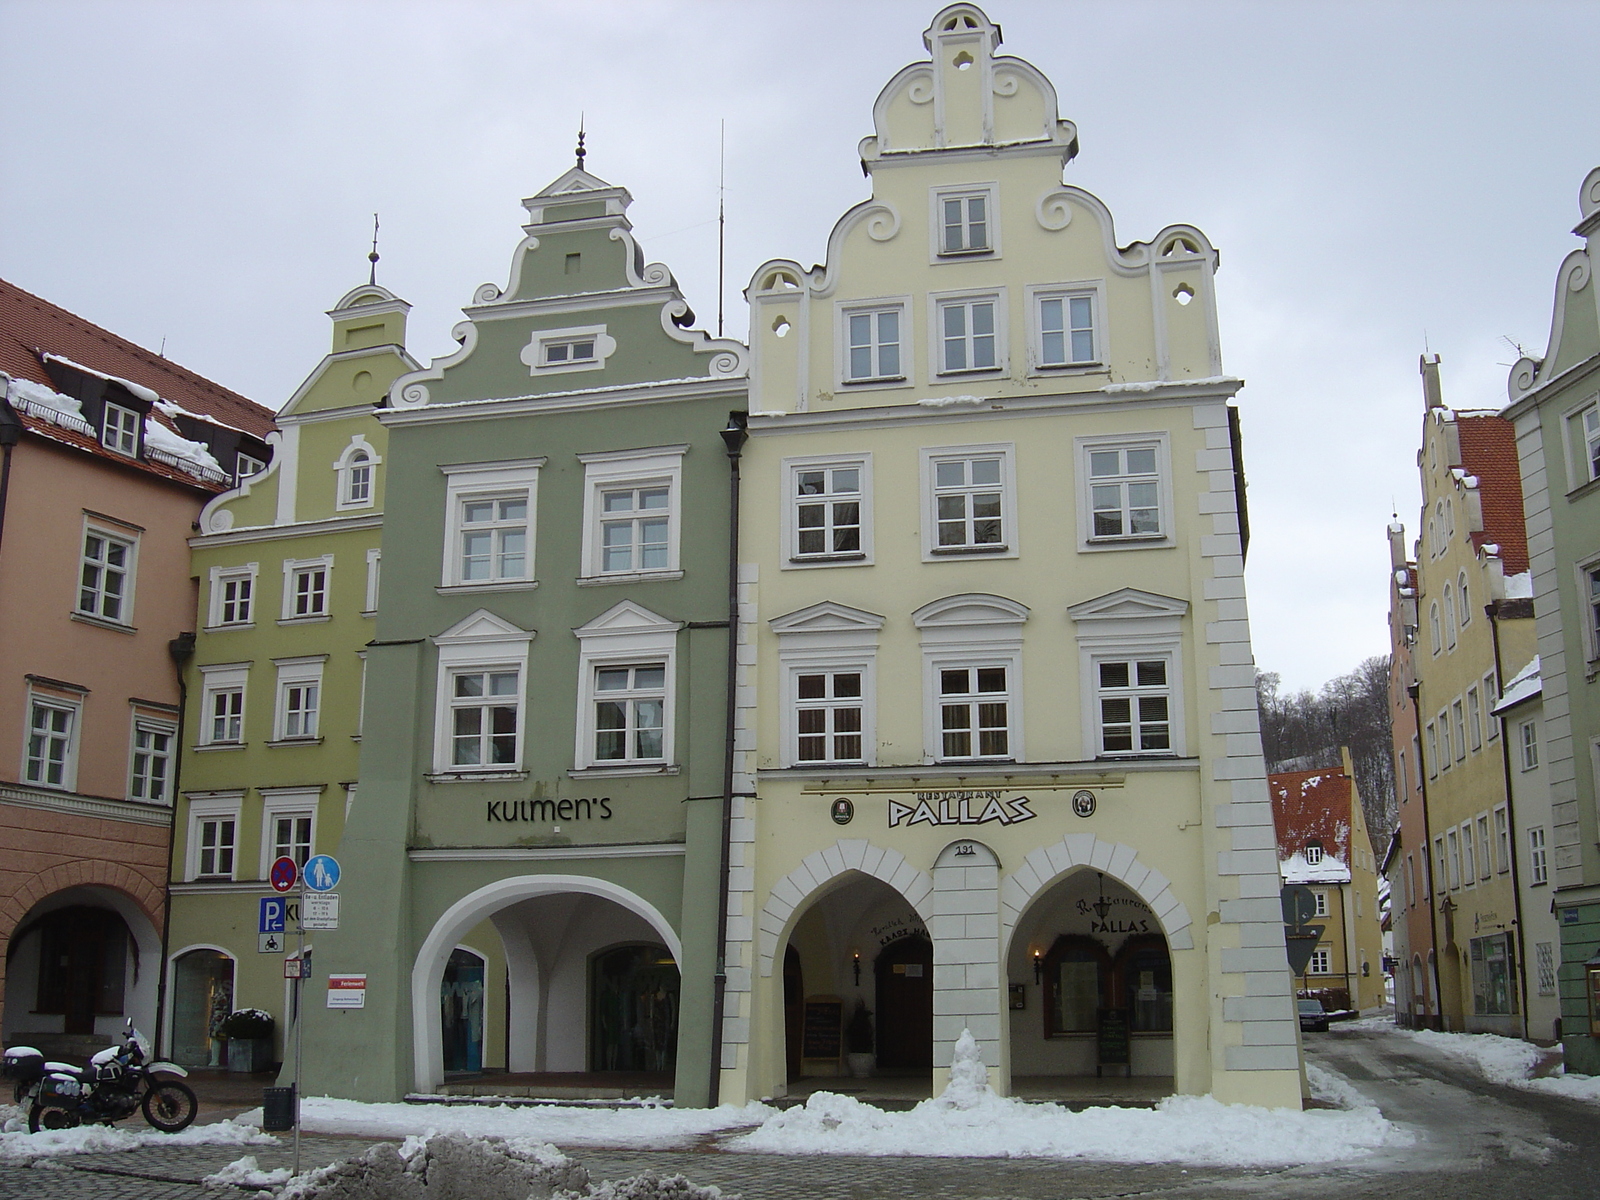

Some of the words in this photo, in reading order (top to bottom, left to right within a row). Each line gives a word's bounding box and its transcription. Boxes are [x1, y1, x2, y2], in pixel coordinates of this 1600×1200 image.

[888, 796, 1038, 829] PALLAS
[955, 844, 976, 857] 191
[265, 901, 280, 931] P
[1091, 919, 1149, 933] PALLAS
